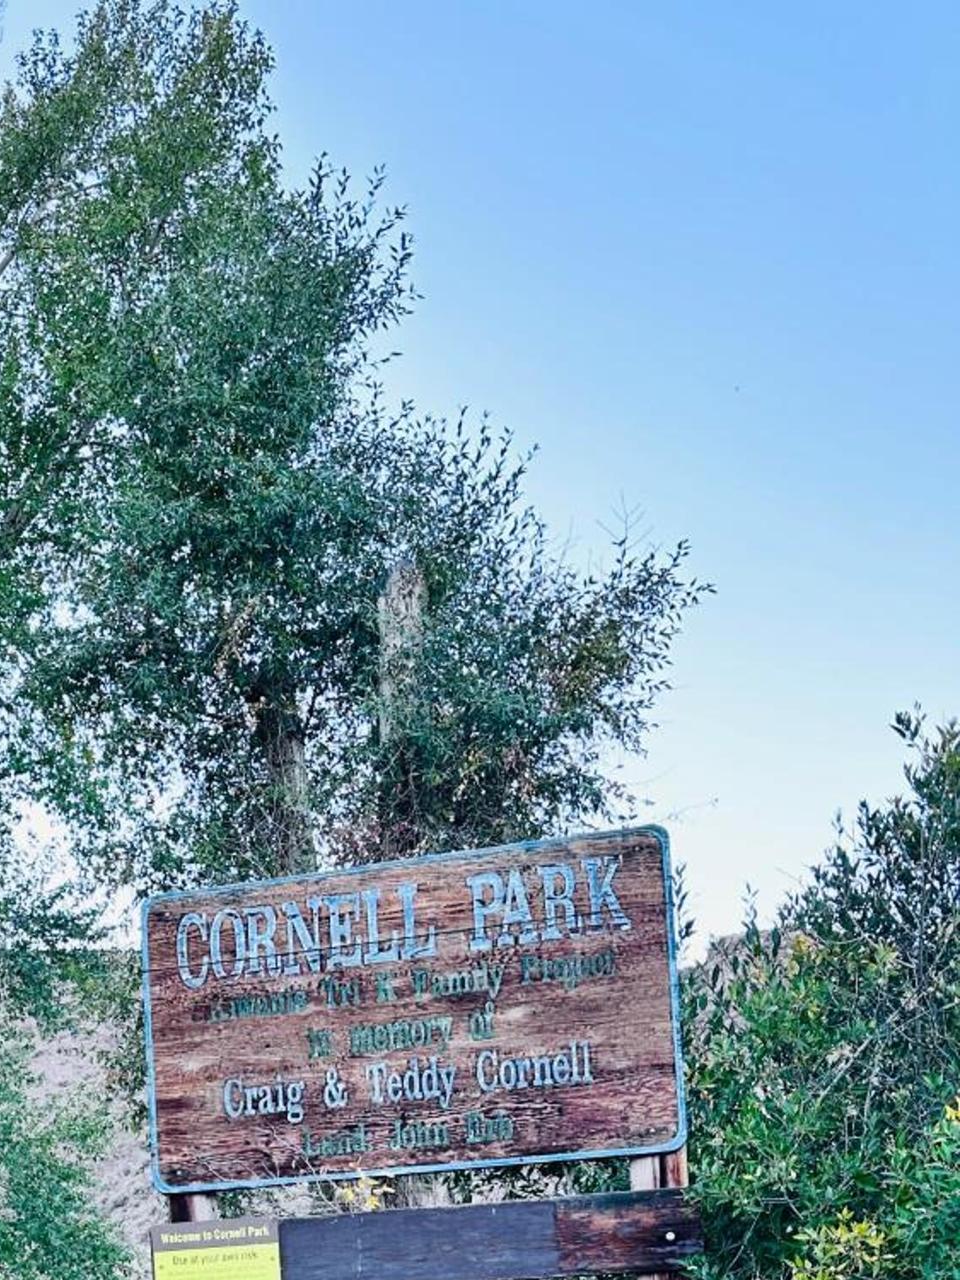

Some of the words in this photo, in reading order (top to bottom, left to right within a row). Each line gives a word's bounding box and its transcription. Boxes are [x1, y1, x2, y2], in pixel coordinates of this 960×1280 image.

[176, 881, 437, 990] CORNELL
[466, 855, 632, 951] PARK
[349, 1014, 454, 1056] memory
[468, 1001, 496, 1041] of
[222, 1074, 305, 1124] Craig
[323, 1067, 348, 1109] &
[365, 1056, 456, 1109] Teddy
[476, 1039, 593, 1096] Cornell
[160, 1231, 202, 1244] Welcome
[203, 1230, 213, 1241] to
[214, 1227, 246, 1241] Cornell
[247, 1225, 270, 1238] Park
